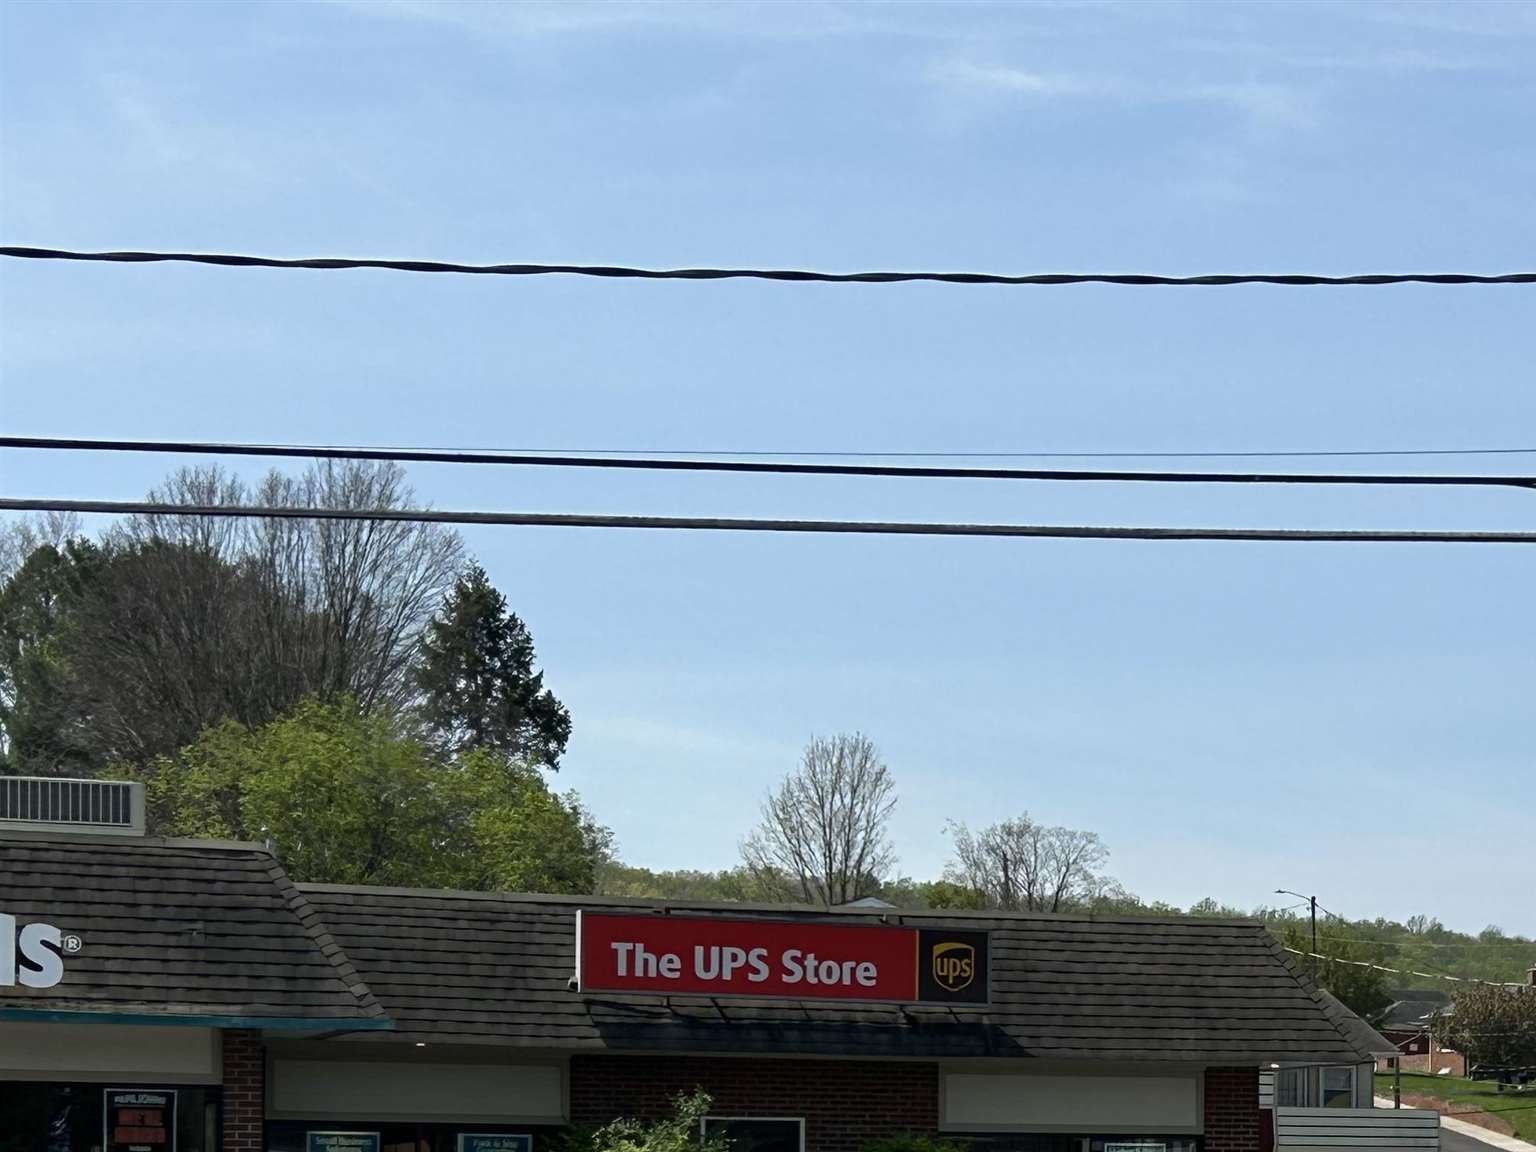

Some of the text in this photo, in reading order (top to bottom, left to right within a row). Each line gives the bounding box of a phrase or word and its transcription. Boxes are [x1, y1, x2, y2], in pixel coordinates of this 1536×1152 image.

[611, 942, 878, 987] The UPS Store
[936, 957, 971, 984] ups
